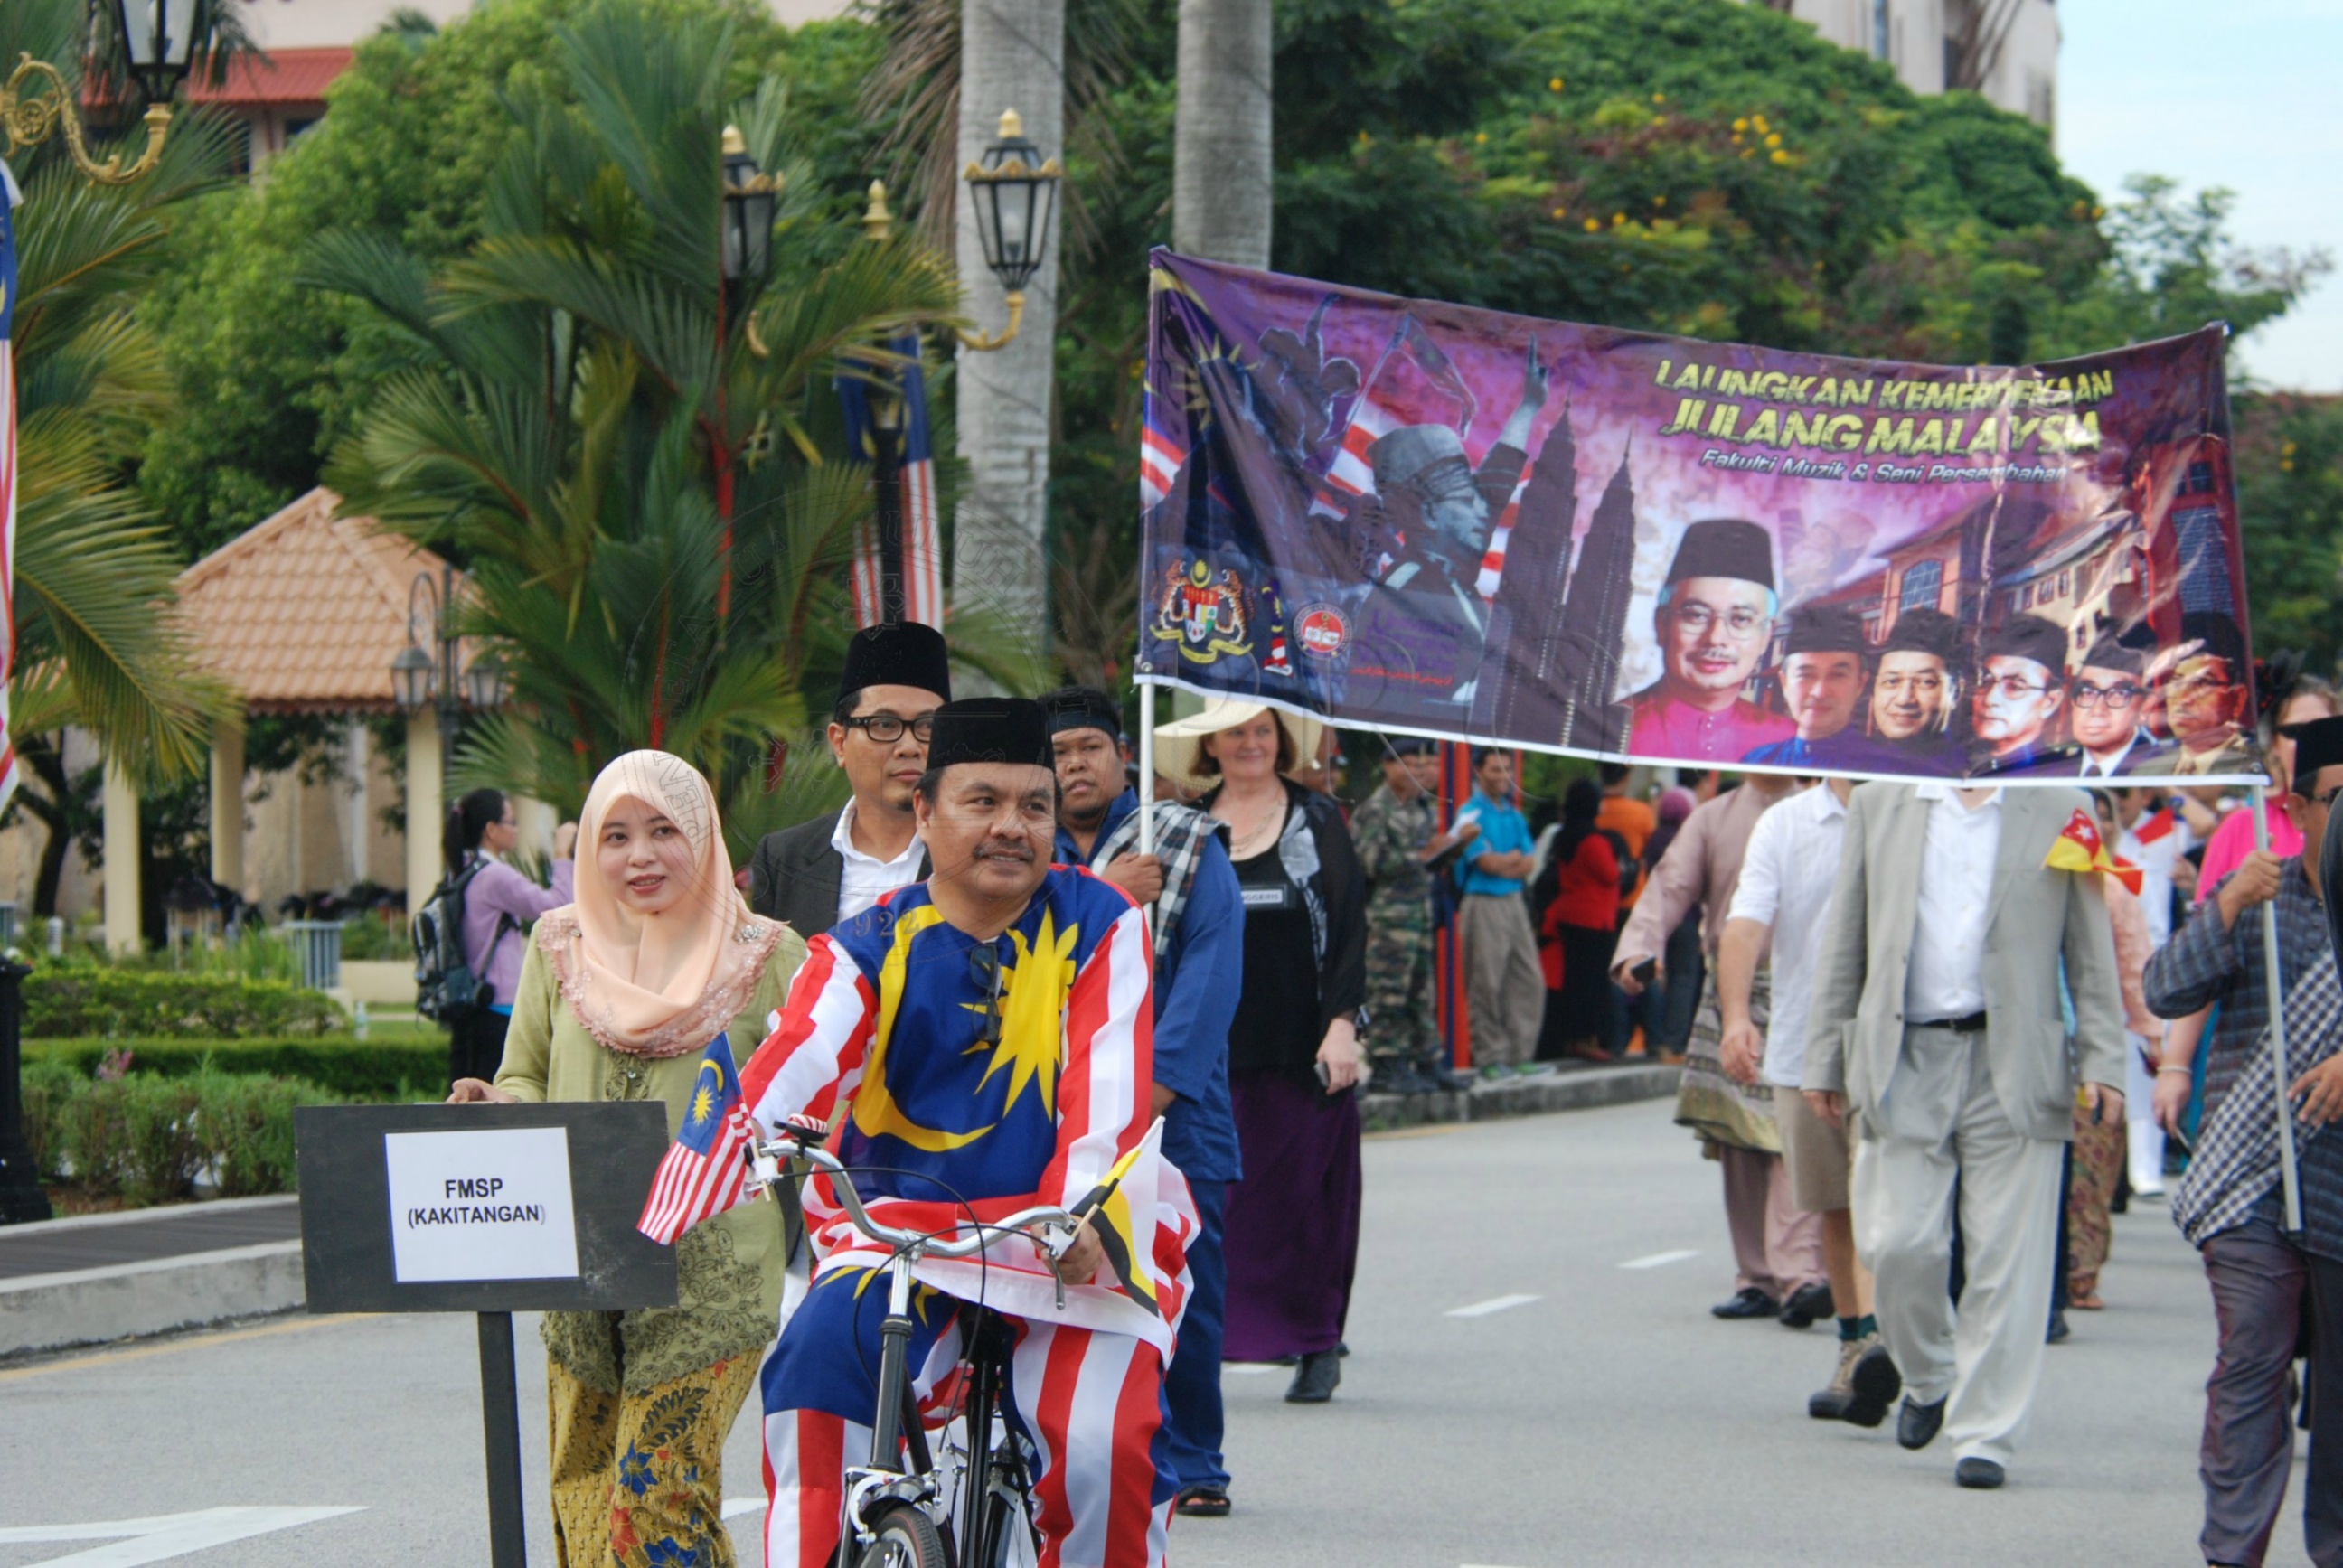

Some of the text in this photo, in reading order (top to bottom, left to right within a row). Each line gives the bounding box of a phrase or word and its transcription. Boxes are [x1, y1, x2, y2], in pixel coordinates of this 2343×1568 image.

[1654, 359, 1875, 407] LAUNGKAN
[1658, 399, 2101, 457] JULANG MALAYSIA
[1700, 449, 2067, 484] Fakulti Muzik & Seni Persembahan
[446, 1178, 503, 1199] FMSP
[408, 1204, 546, 1230] (KAKITANGAN)
